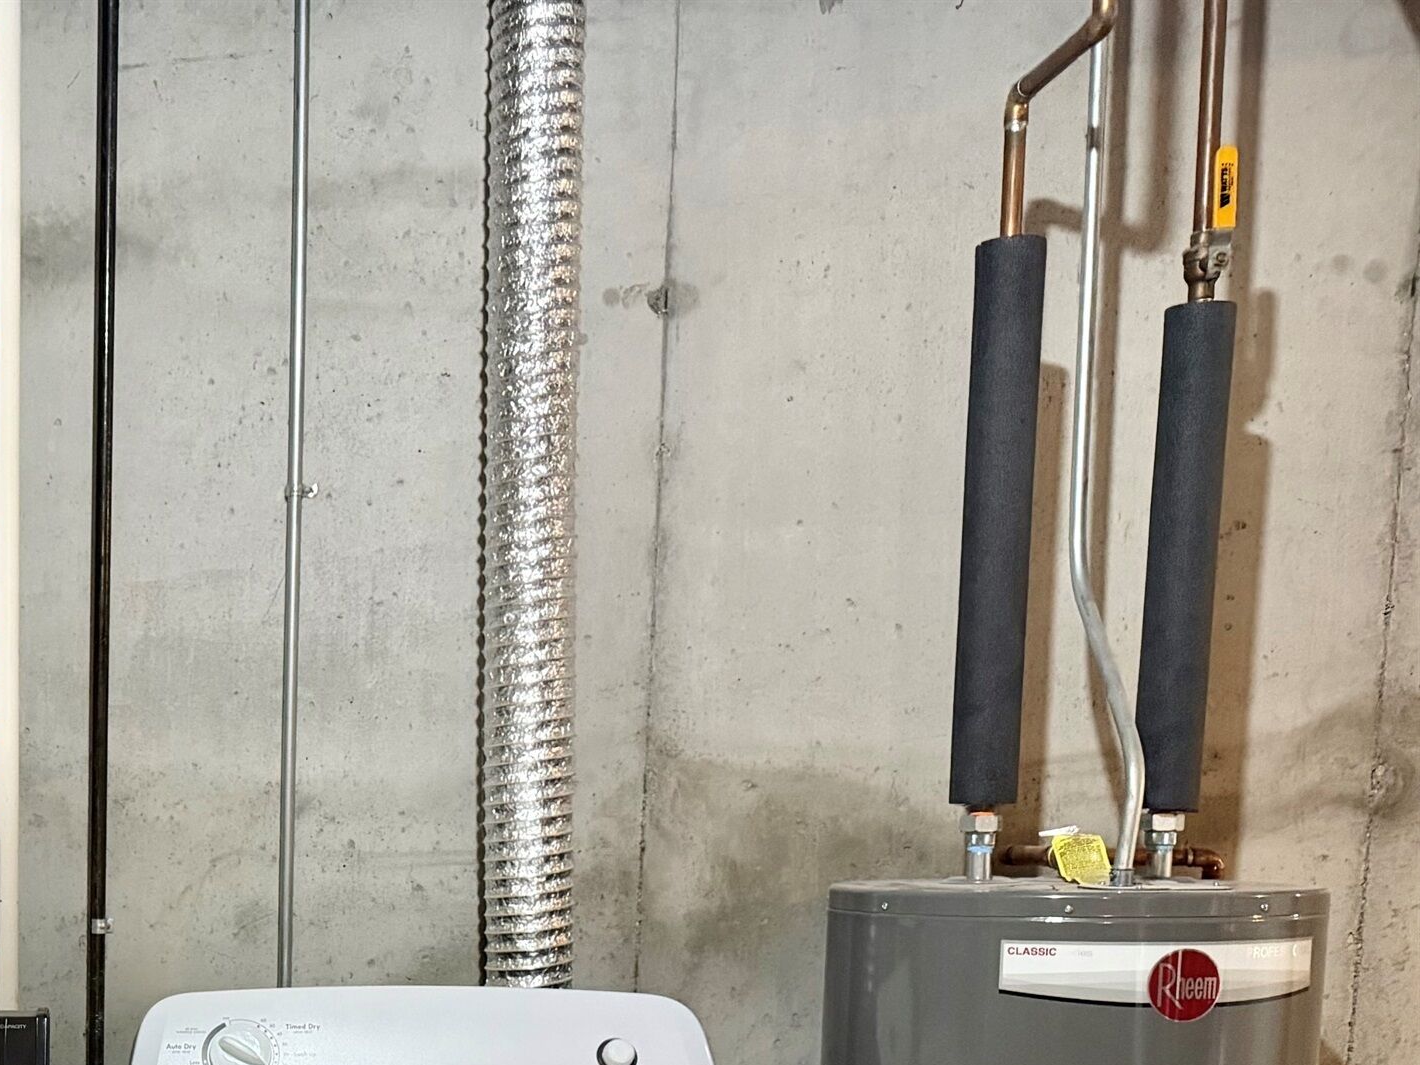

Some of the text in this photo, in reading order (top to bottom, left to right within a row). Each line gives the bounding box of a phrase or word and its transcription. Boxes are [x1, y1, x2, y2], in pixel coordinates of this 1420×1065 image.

[1007, 946, 1057, 956] CLASSIC
[1157, 950, 1217, 1010] Rheem
[308, 1023, 320, 1031] Dry
[183, 1043, 196, 1051] Dry
